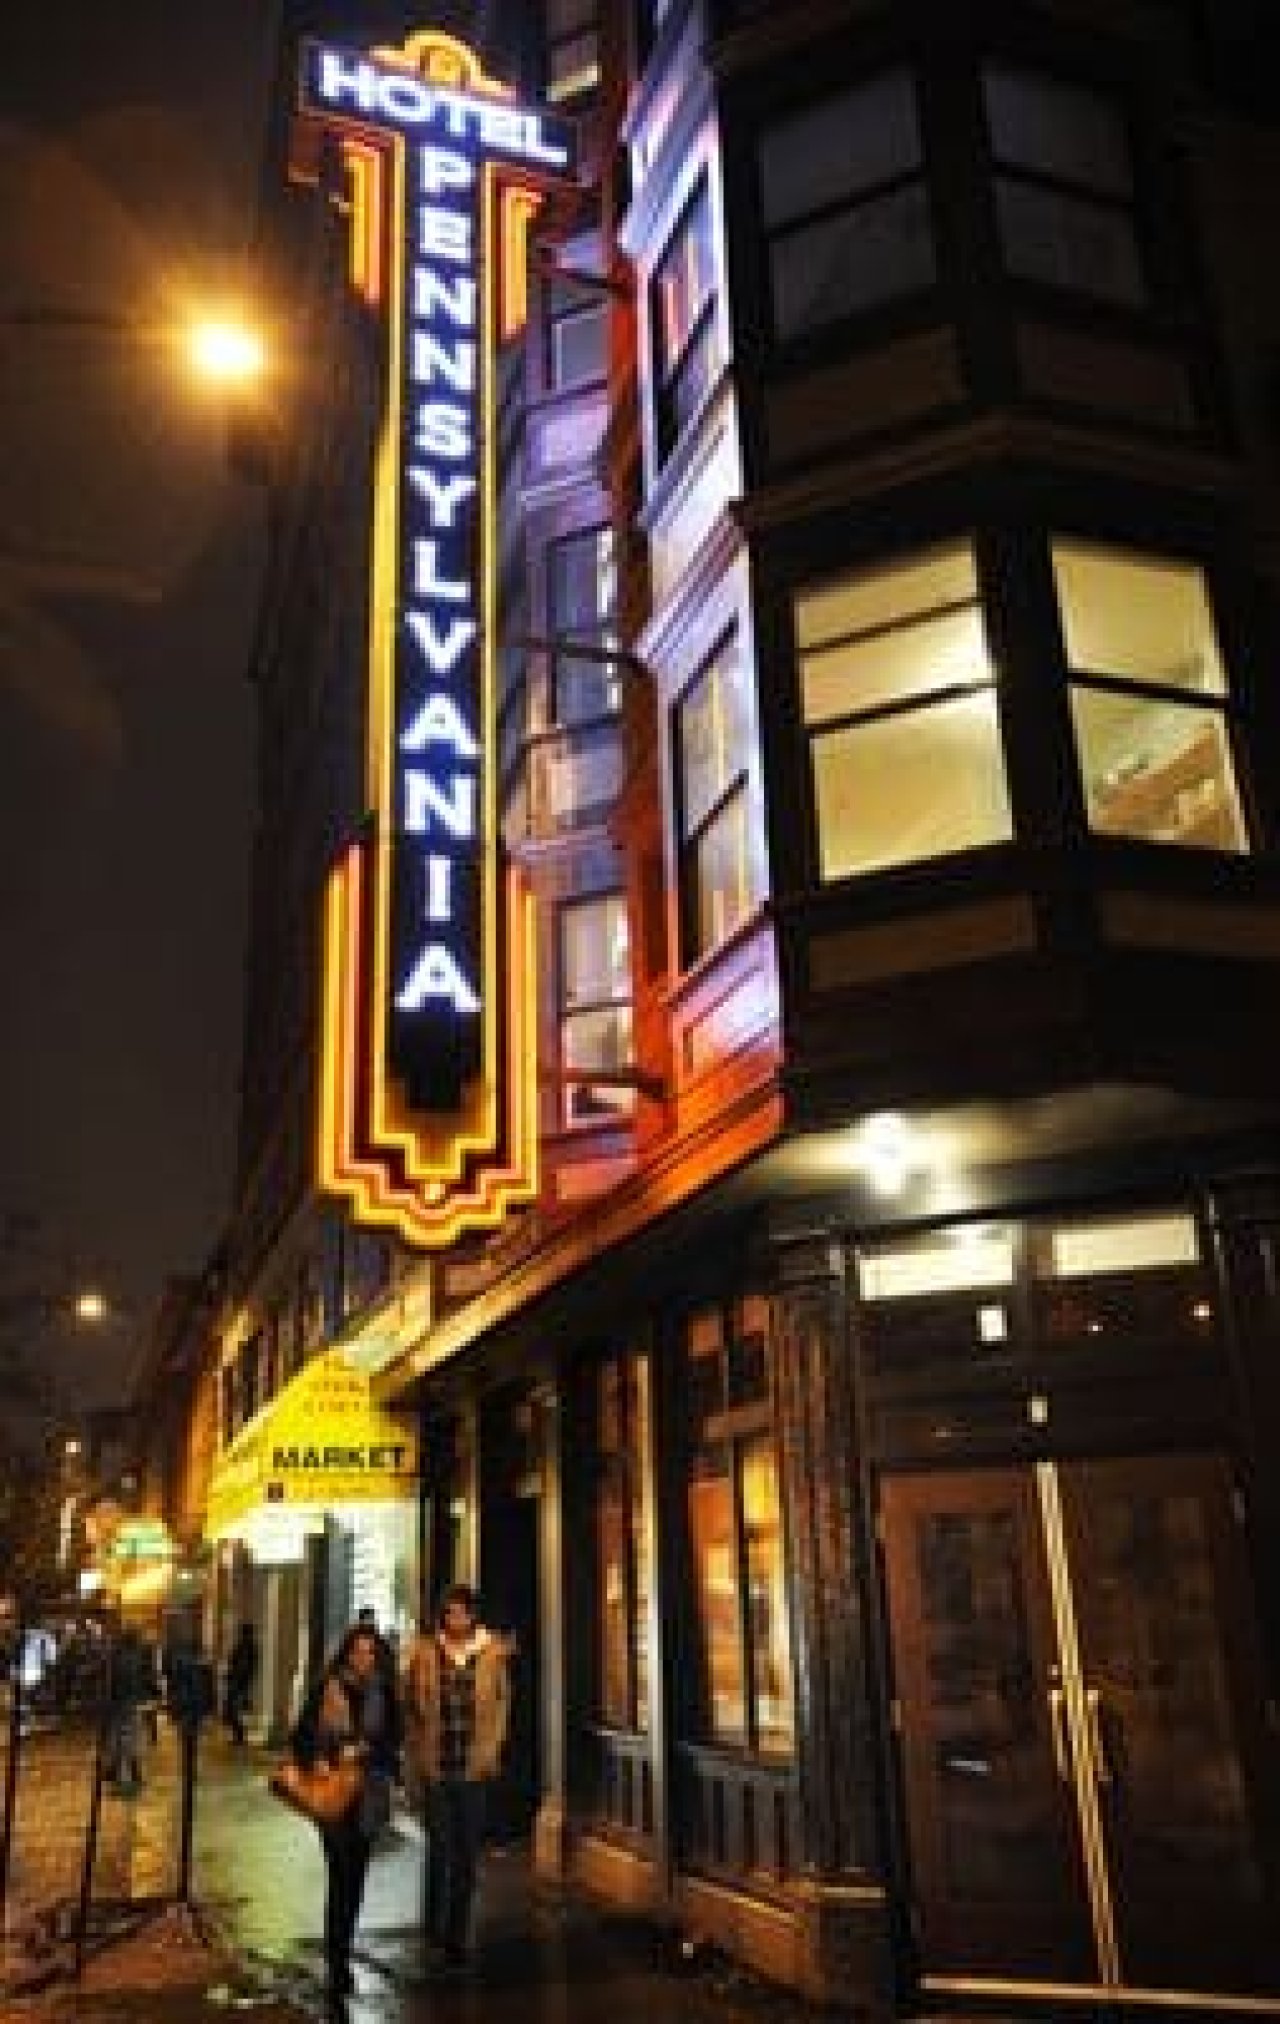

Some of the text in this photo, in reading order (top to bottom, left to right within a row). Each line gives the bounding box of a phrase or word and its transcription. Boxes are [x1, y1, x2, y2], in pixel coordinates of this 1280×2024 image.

[317, 51, 568, 164] HOTEL
[397, 145, 481, 1012] PENNSYLVANIA
[272, 1446, 406, 1469] MARKET
